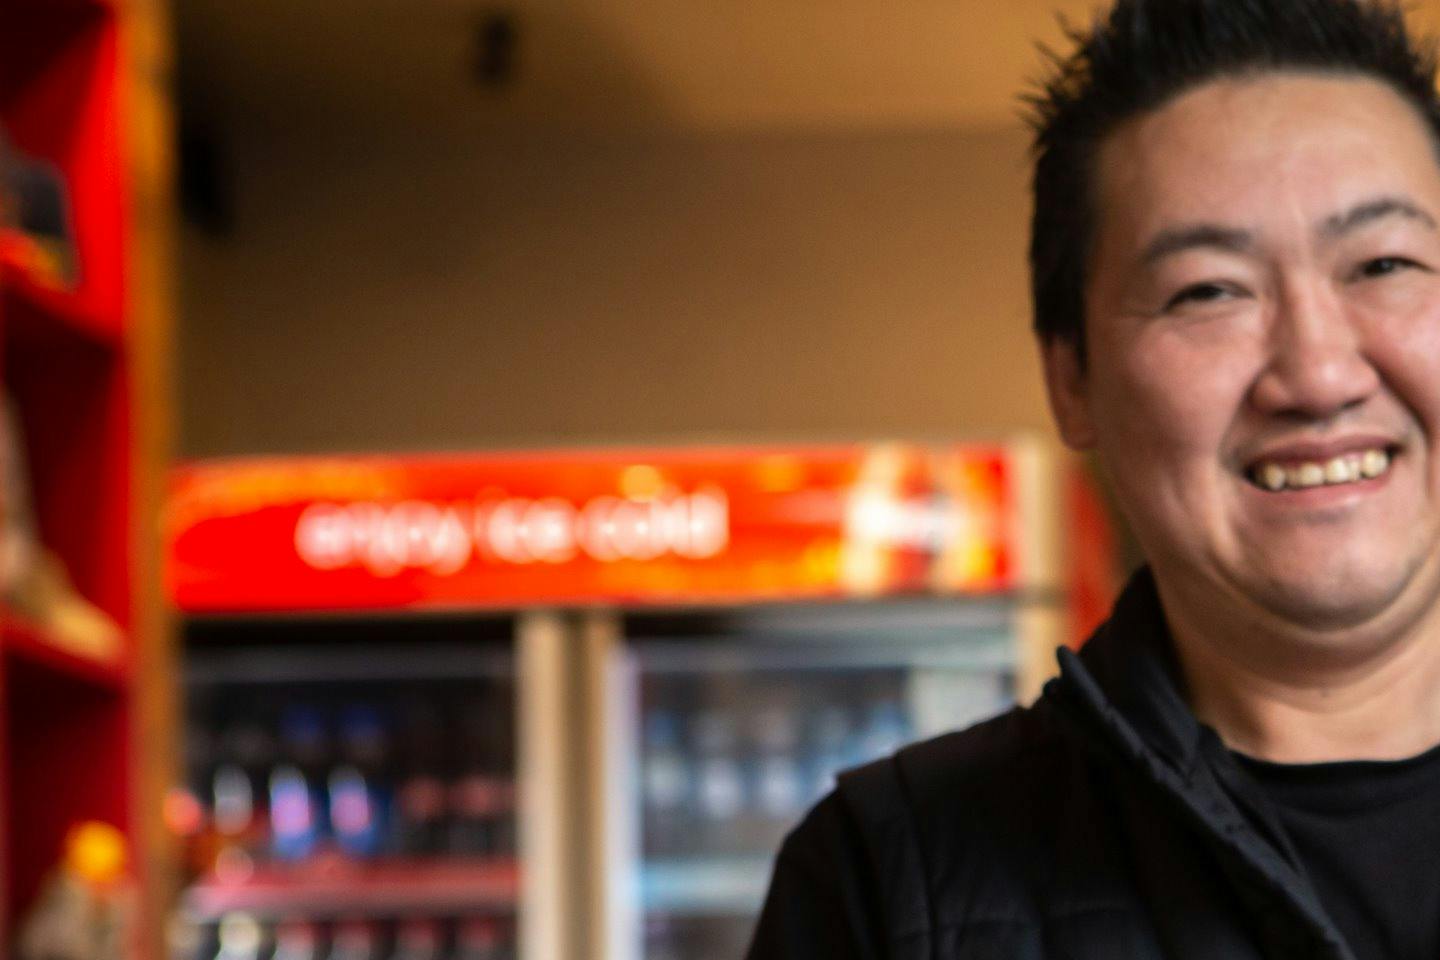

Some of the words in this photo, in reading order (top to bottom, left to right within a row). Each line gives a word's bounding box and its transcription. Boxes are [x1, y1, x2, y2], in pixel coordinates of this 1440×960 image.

[295, 500, 471, 576] enjoy
[475, 490, 578, 563] ice
[577, 488, 729, 561] cold
